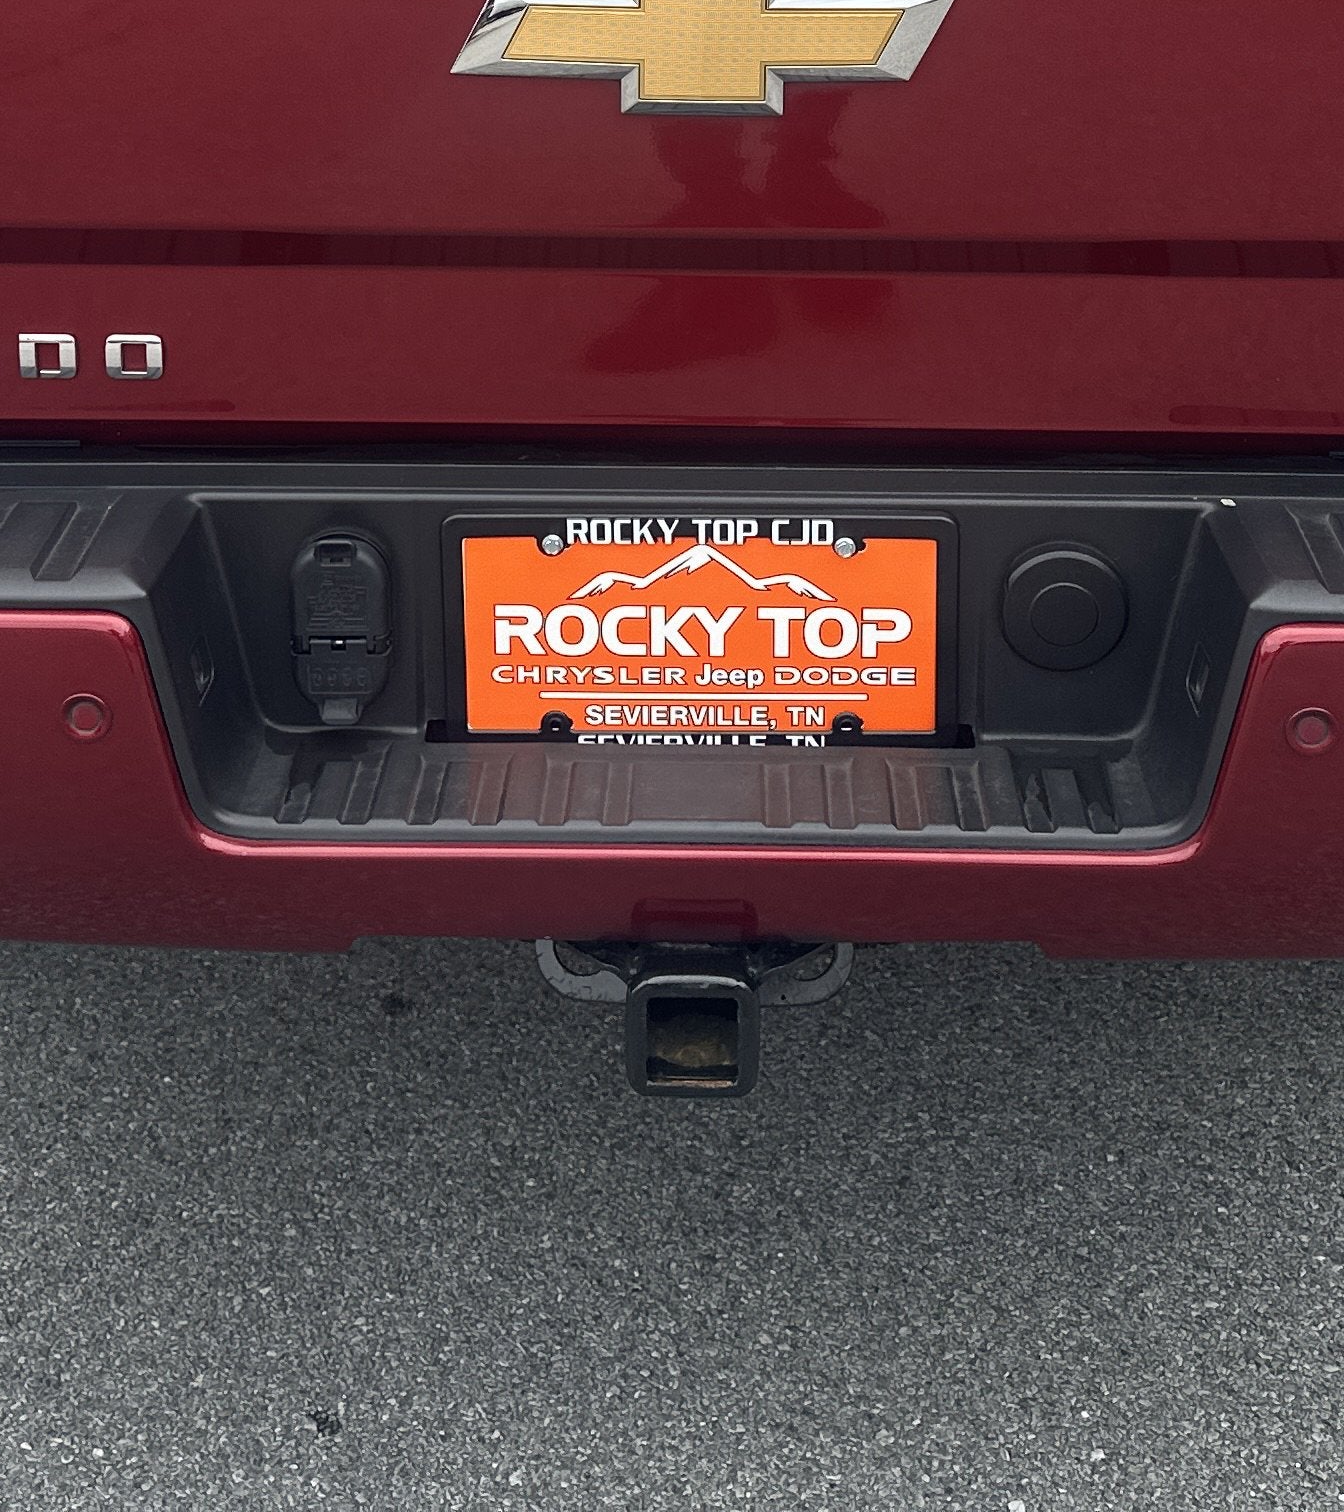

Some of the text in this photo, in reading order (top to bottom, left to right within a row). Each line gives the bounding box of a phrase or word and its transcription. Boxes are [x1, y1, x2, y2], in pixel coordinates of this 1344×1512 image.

[566, 518, 834, 546] ROCKY TOP CJD
[493, 604, 913, 659] ROCKY TOP
[491, 663, 917, 689] CHRYSLER Jeep DODGE
[584, 704, 825, 731] SEVIERVILLE, TN
